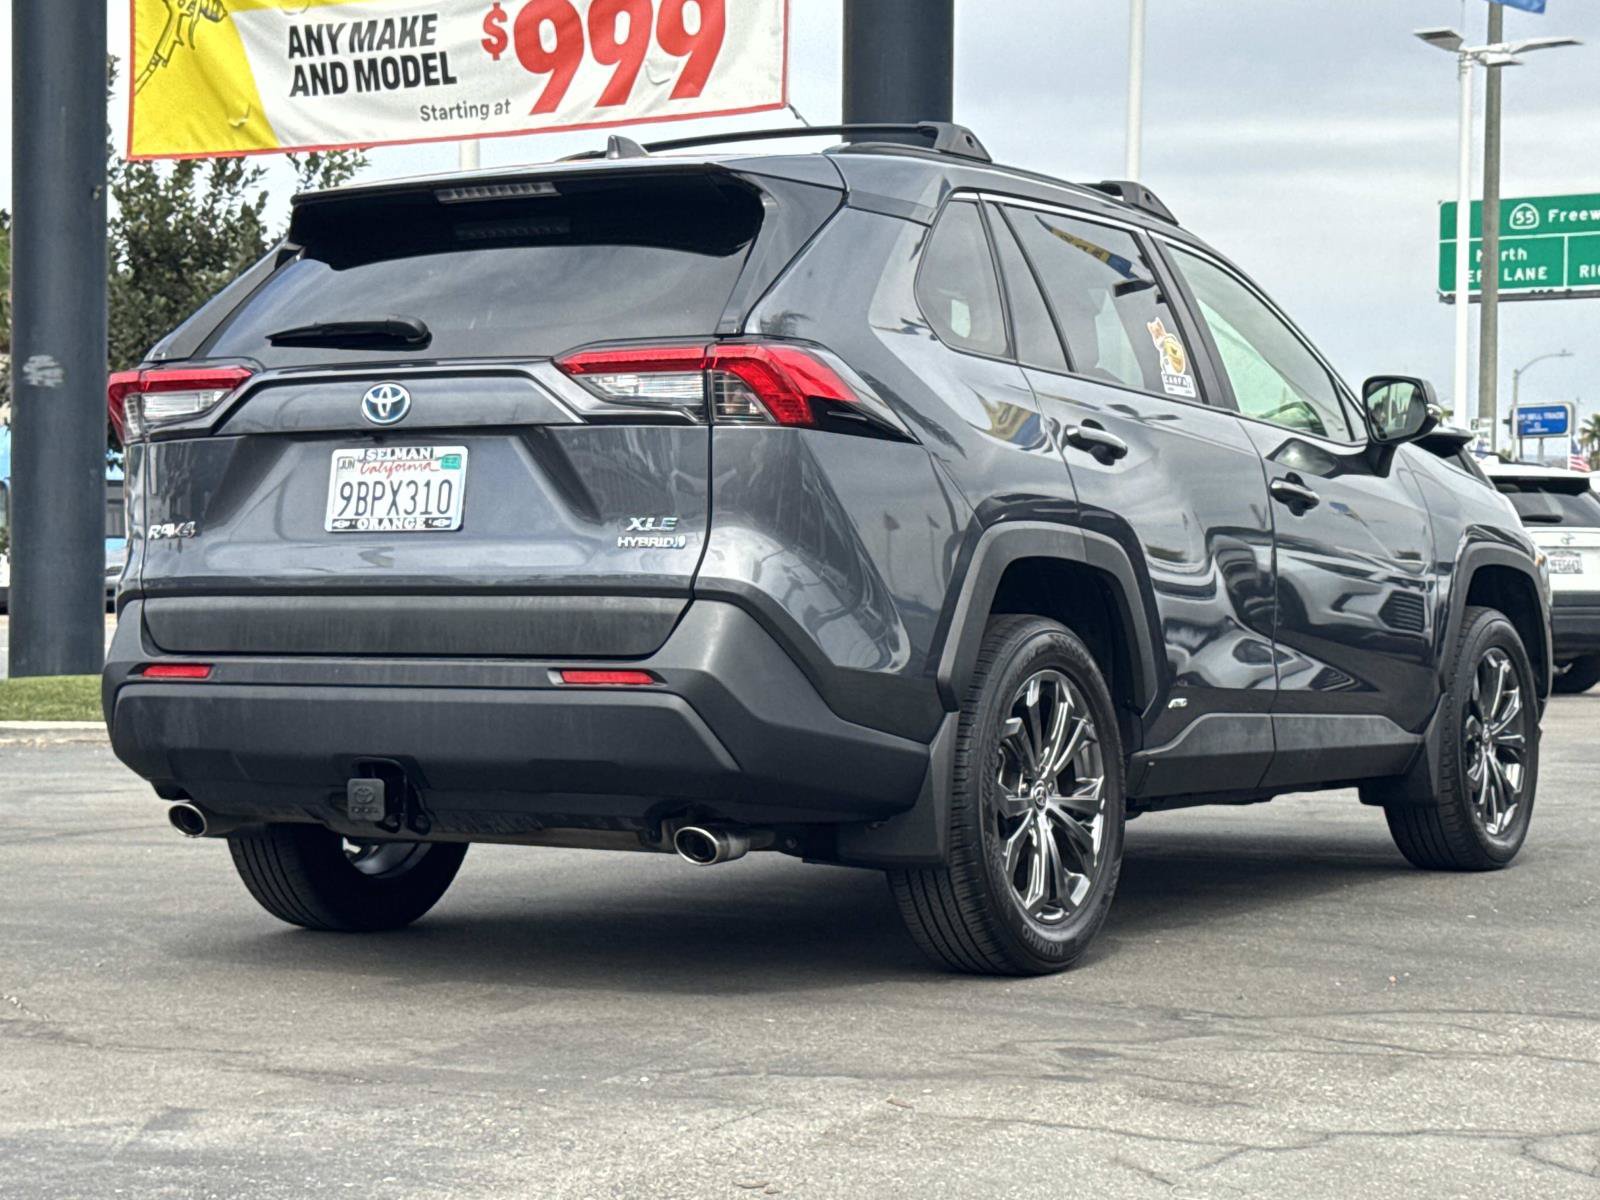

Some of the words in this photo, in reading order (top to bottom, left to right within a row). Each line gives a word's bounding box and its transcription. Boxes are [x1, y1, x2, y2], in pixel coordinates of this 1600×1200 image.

[288, 22, 347, 59] ANY
[348, 13, 438, 53] MAKE
[481, 0, 726, 115] $999
[289, 60, 349, 97] AND
[353, 51, 457, 93] MODEL
[420, 100, 490, 122] Starting
[494, 98, 511, 116] at
[1515, 210, 1534, 224] 55
[1503, 266, 1548, 281] LANE
[1579, 264, 1600, 278] RI
[339, 458, 355, 470] JUN
[360, 459, 440, 479] California
[338, 479, 453, 517] 9BPX310
[148, 521, 196, 539] RAV4
[356, 517, 426, 530] ORANGE
[626, 517, 679, 531] XLE
[617, 535, 674, 548] HYBRID
[1022, 924, 1063, 957] KUMHO
